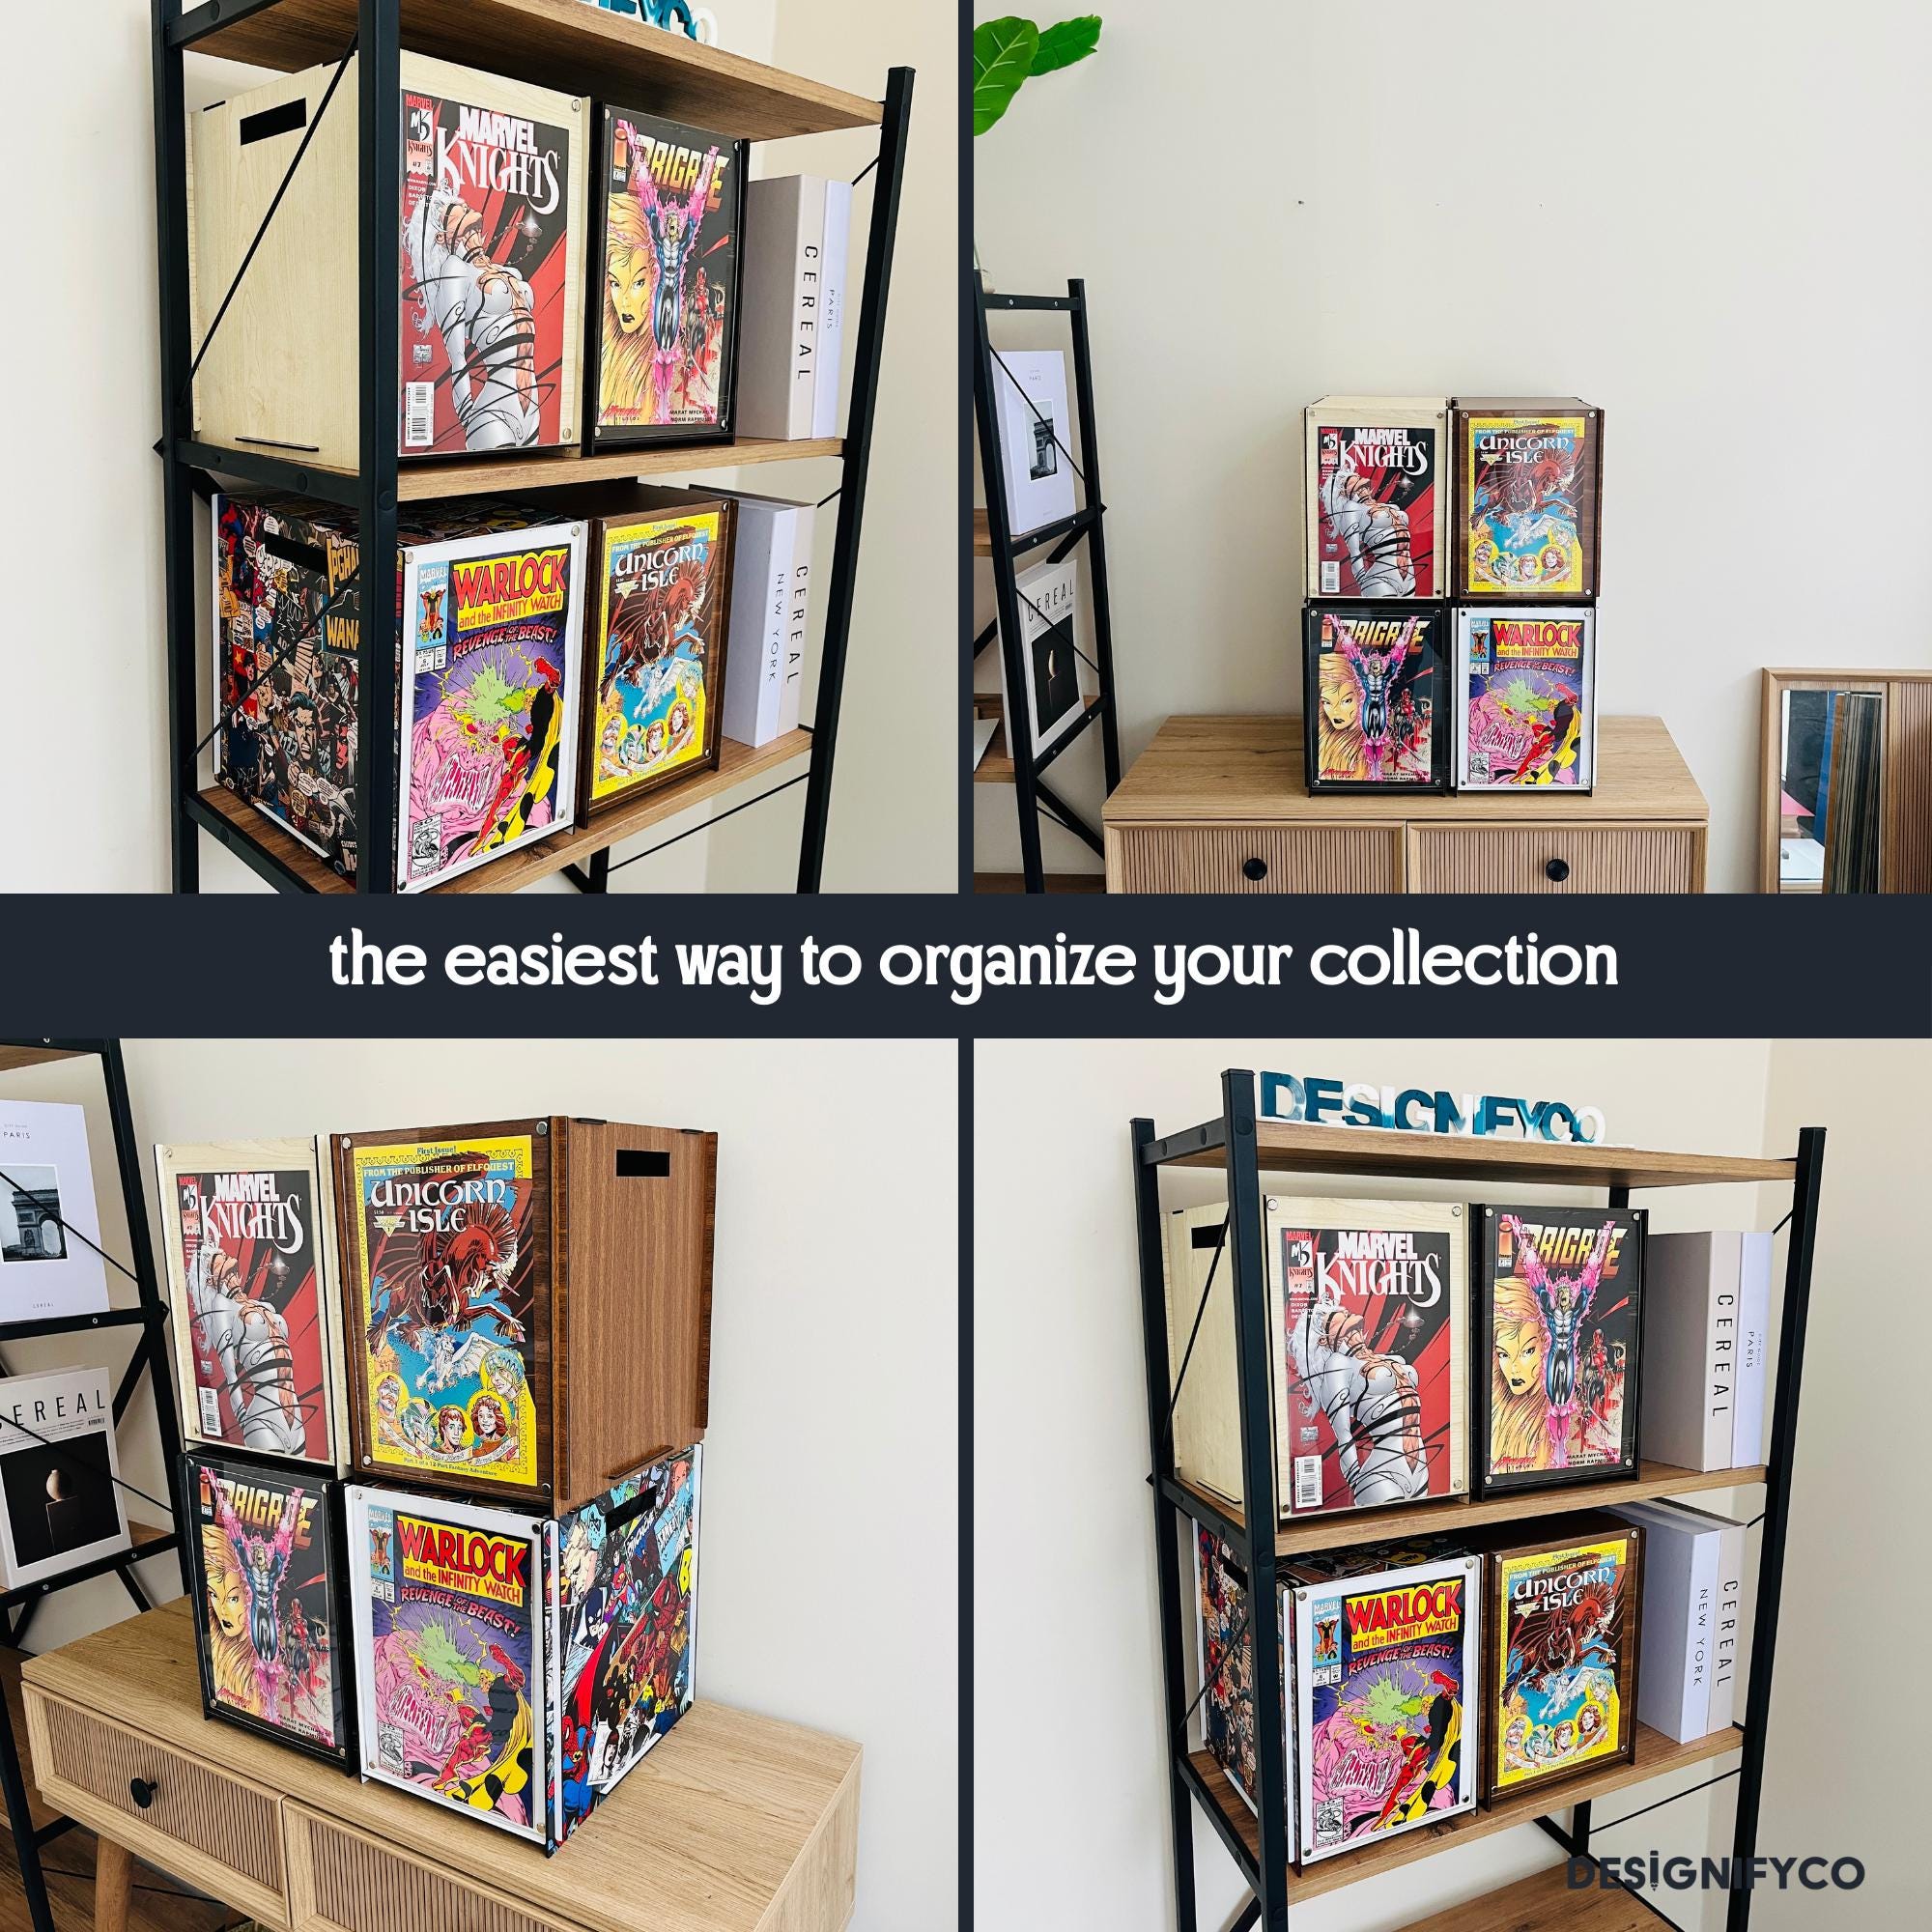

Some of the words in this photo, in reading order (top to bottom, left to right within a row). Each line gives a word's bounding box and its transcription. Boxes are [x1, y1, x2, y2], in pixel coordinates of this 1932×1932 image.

[405, 94, 434, 111] MARVEL
[459, 104, 539, 156] MARVEL
[436, 126, 561, 215] KNIGHTS
[798, 245, 818, 380] CEREAL
[826, 289, 837, 331] PARIS
[1354, 428, 1410, 446] MARVEL
[1340, 440, 1428, 476] KNIGHTS
[1506, 450, 1544, 464] ISLE
[611, 545, 630, 554] FROM
[642, 535, 674, 548] PUBLISHER
[682, 529, 710, 540] ELFQUEST
[419, 565, 448, 580] MARVEL
[453, 554, 568, 611] WARLOCK
[641, 566, 679, 591] ISLE
[459, 612, 476, 629] and
[478, 611, 492, 624] the
[493, 600, 528, 621] INFINITY
[530, 593, 561, 612] WATCH
[774, 573, 785, 615] NEW
[1028, 579, 1074, 622] CEREAL
[505, 633, 517, 643] THE
[508, 626, 519, 635] OF
[518, 625, 557, 644] BEAST!
[787, 565, 809, 684] CEREAL
[1493, 623, 1581, 647] WARLOCK
[453, 627, 507, 662] REVENGE
[769, 628, 780, 682] YORK
[1497, 647, 1509, 656] and
[1511, 647, 1520, 656] the
[1521, 647, 1549, 656] INFINITY
[1552, 647, 1577, 657] WATCH
[1494, 660, 1531, 672] REVENGE
[1541, 660, 1576, 676] BEAST!
[416, 1147, 433, 1155] First
[363, 1168, 386, 1177] FROM
[387, 1167, 403, 1176] THE
[404, 1165, 452, 1176] PUBLISHER
[453, 1164, 465, 1173] OF
[467, 1161, 515, 1172] ELFQUEST
[214, 1173, 280, 1203] MARVEL
[200, 1194, 304, 1254] KNIGHTS
[408, 1208, 468, 1233] ISLE
[1286, 1231, 1313, 1240] MARVEL
[1338, 1232, 1418, 1260] MARVEL
[1316, 1252, 1441, 1308] KNIGHTS
[1712, 1293, 1734, 1417] CEREAL
[1746, 1331, 1755, 1368] PARIS
[0, 1389, 105, 1430] EREAL
[448, 1463, 469, 1473] Fantasy
[469, 1467, 497, 1476] Adventure
[397, 1520, 527, 1587] WARLOCK
[1542, 1563, 1577, 1575] PUBLISHER
[1586, 1555, 1616, 1566] ELFQUEST
[405, 1566, 421, 1580] and
[423, 1567, 437, 1581] the
[438, 1571, 480, 1592] INFINITY
[484, 1579, 521, 1605] WATCH
[1543, 1588, 1584, 1611] ISLE
[400, 1586, 454, 1608] REVENGE
[453, 1604, 468, 1613] THE
[468, 1602, 521, 1638] BEAST!
[1314, 1601, 1340, 1613] MARVEL
[1346, 1583, 1462, 1634] WARLOCK
[1698, 1588, 1708, 1627] NEW
[1352, 1634, 1370, 1649] and
[1372, 1633, 1384, 1644] the
[1386, 1624, 1422, 1642] INFINITY
[1426, 1617, 1457, 1633] WATCH
[1717, 1579, 1738, 1688] CEREAL
[1348, 1645, 1401, 1676] REVENGE
[1412, 1643, 1454, 1659] BEAST!
[1693, 1637, 1705, 1686] YORK
